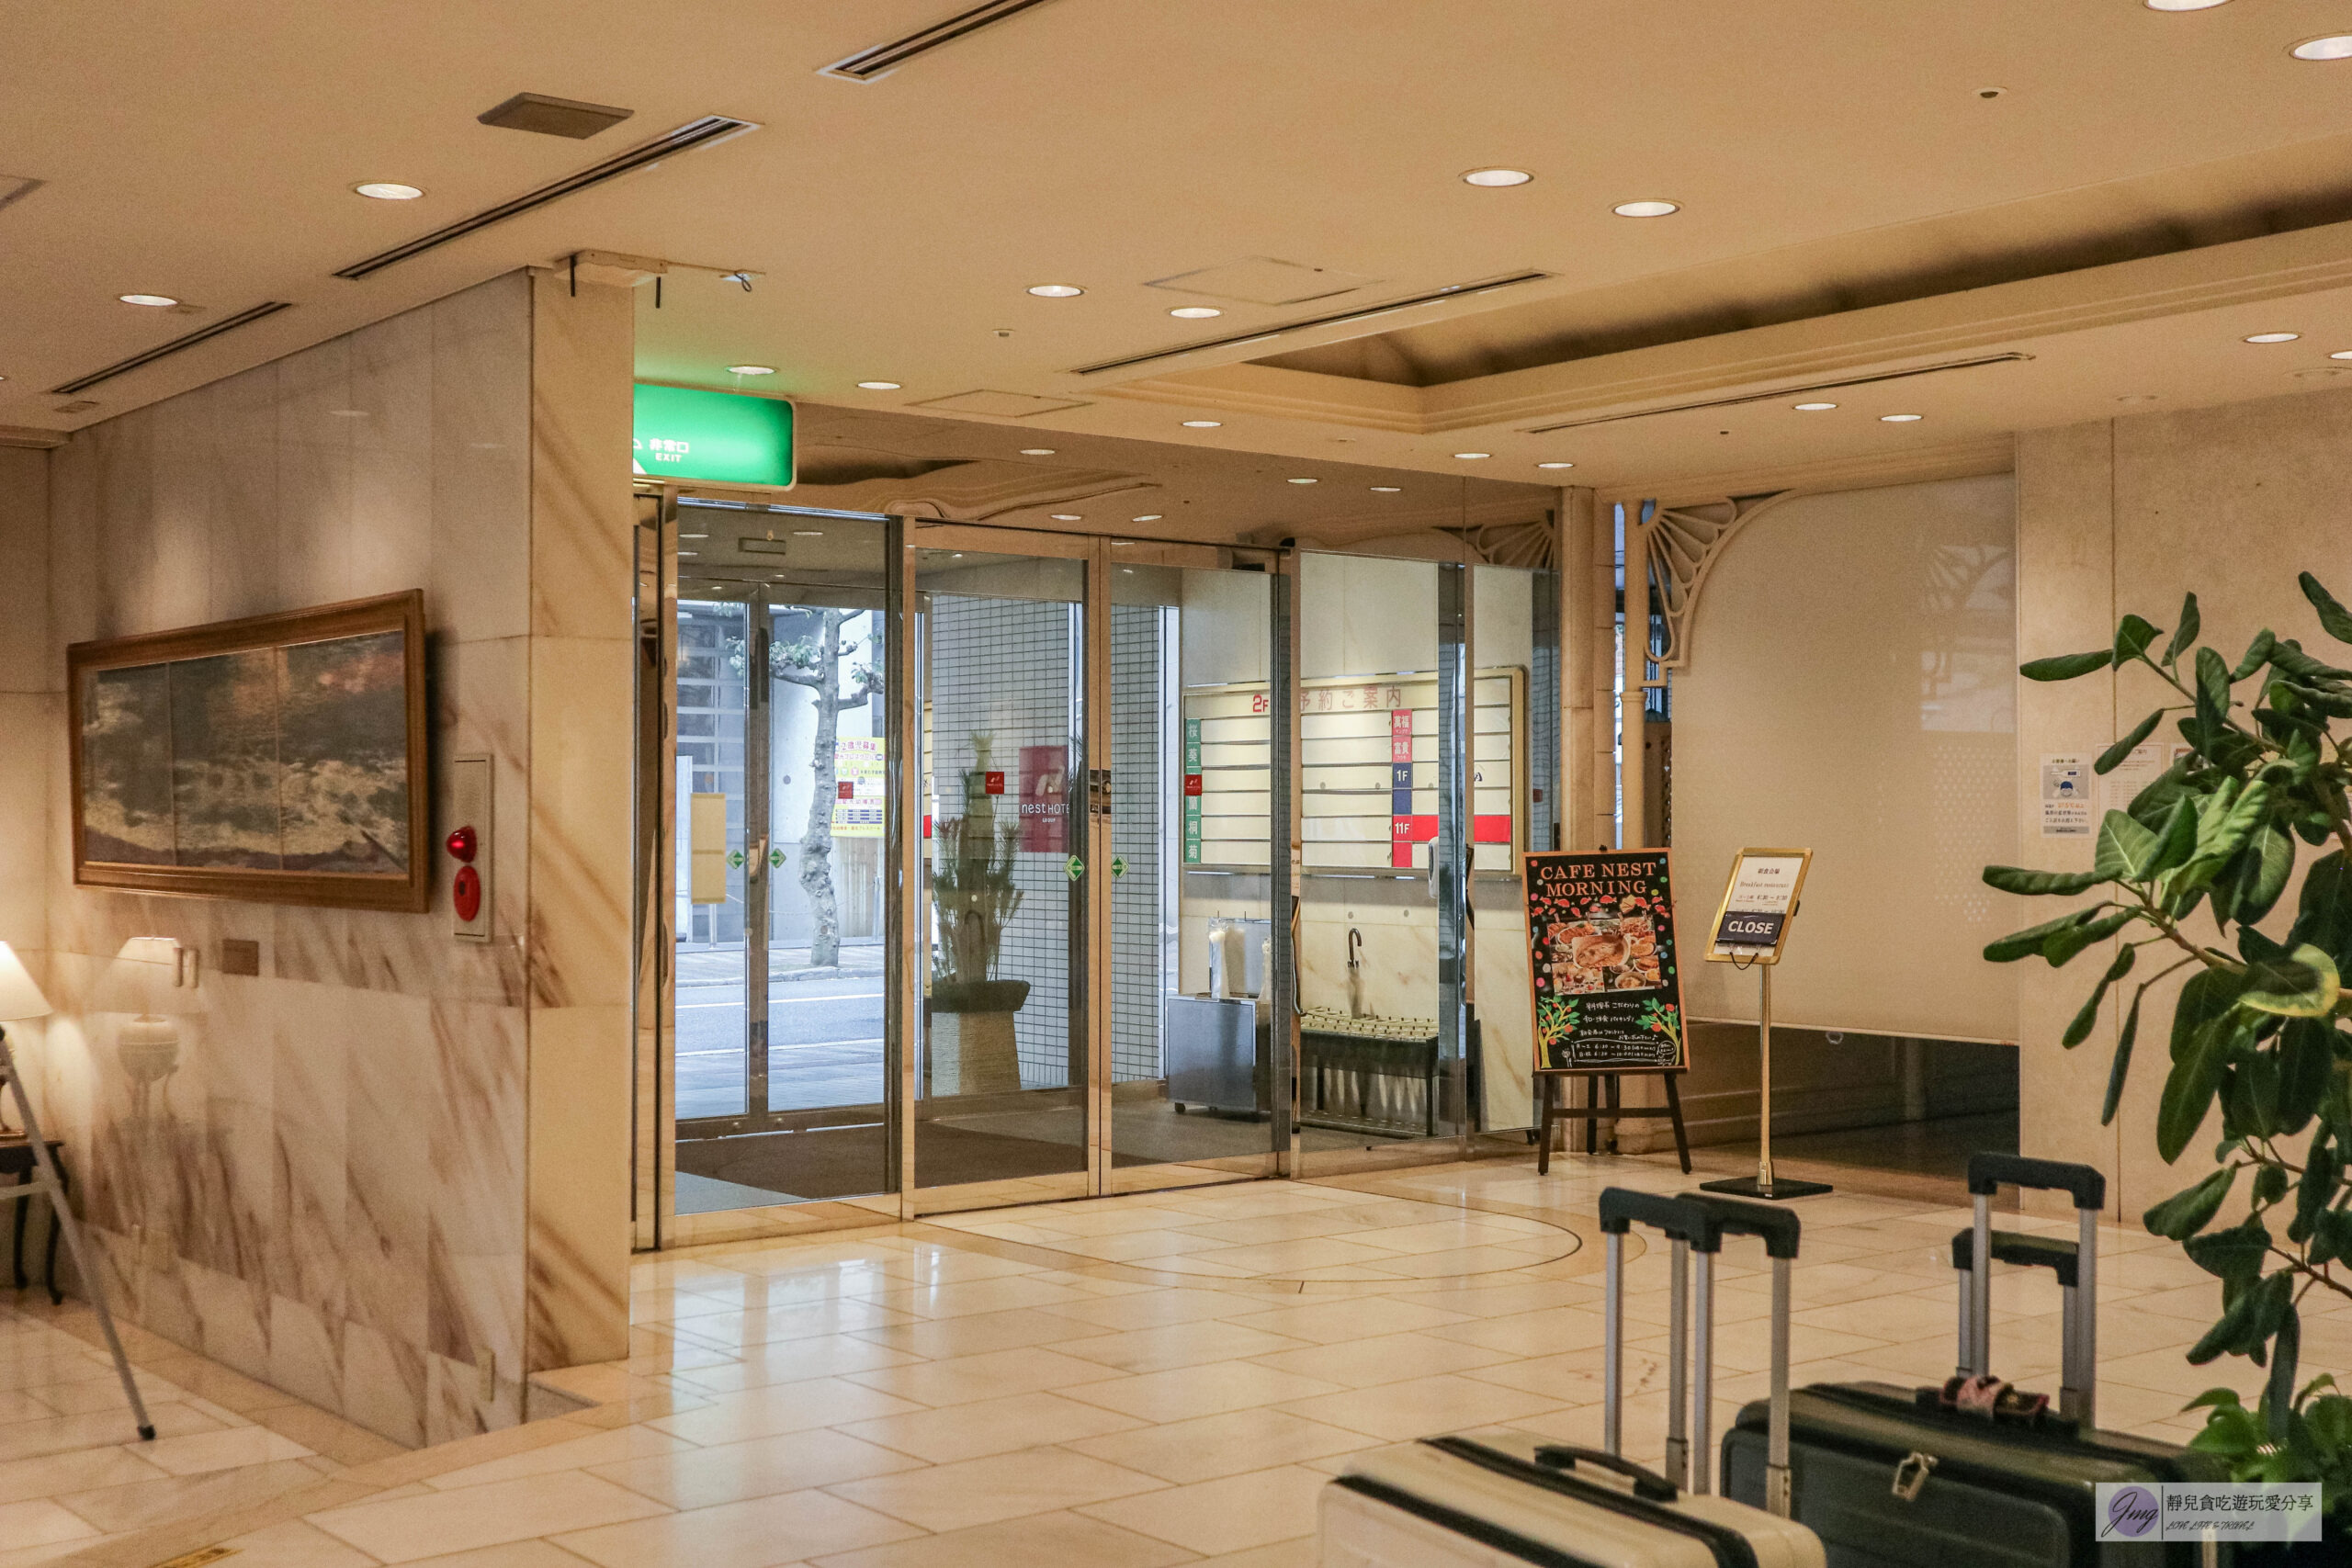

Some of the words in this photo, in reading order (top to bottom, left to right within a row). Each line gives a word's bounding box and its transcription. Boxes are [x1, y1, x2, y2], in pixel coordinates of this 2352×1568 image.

[650, 438, 689, 454] 非常口
[655, 453, 682, 462] EXIT
[1252, 694, 1270, 713] 2F
[1396, 769, 1408, 782] 1F
[1021, 803, 1046, 814] nest
[1395, 822, 1410, 834] 11F
[1540, 863, 1595, 880] CAFE
[1601, 862, 1657, 878] NEST
[1546, 880, 1647, 897] MORNING
[1727, 920, 1774, 934] CLOSE
